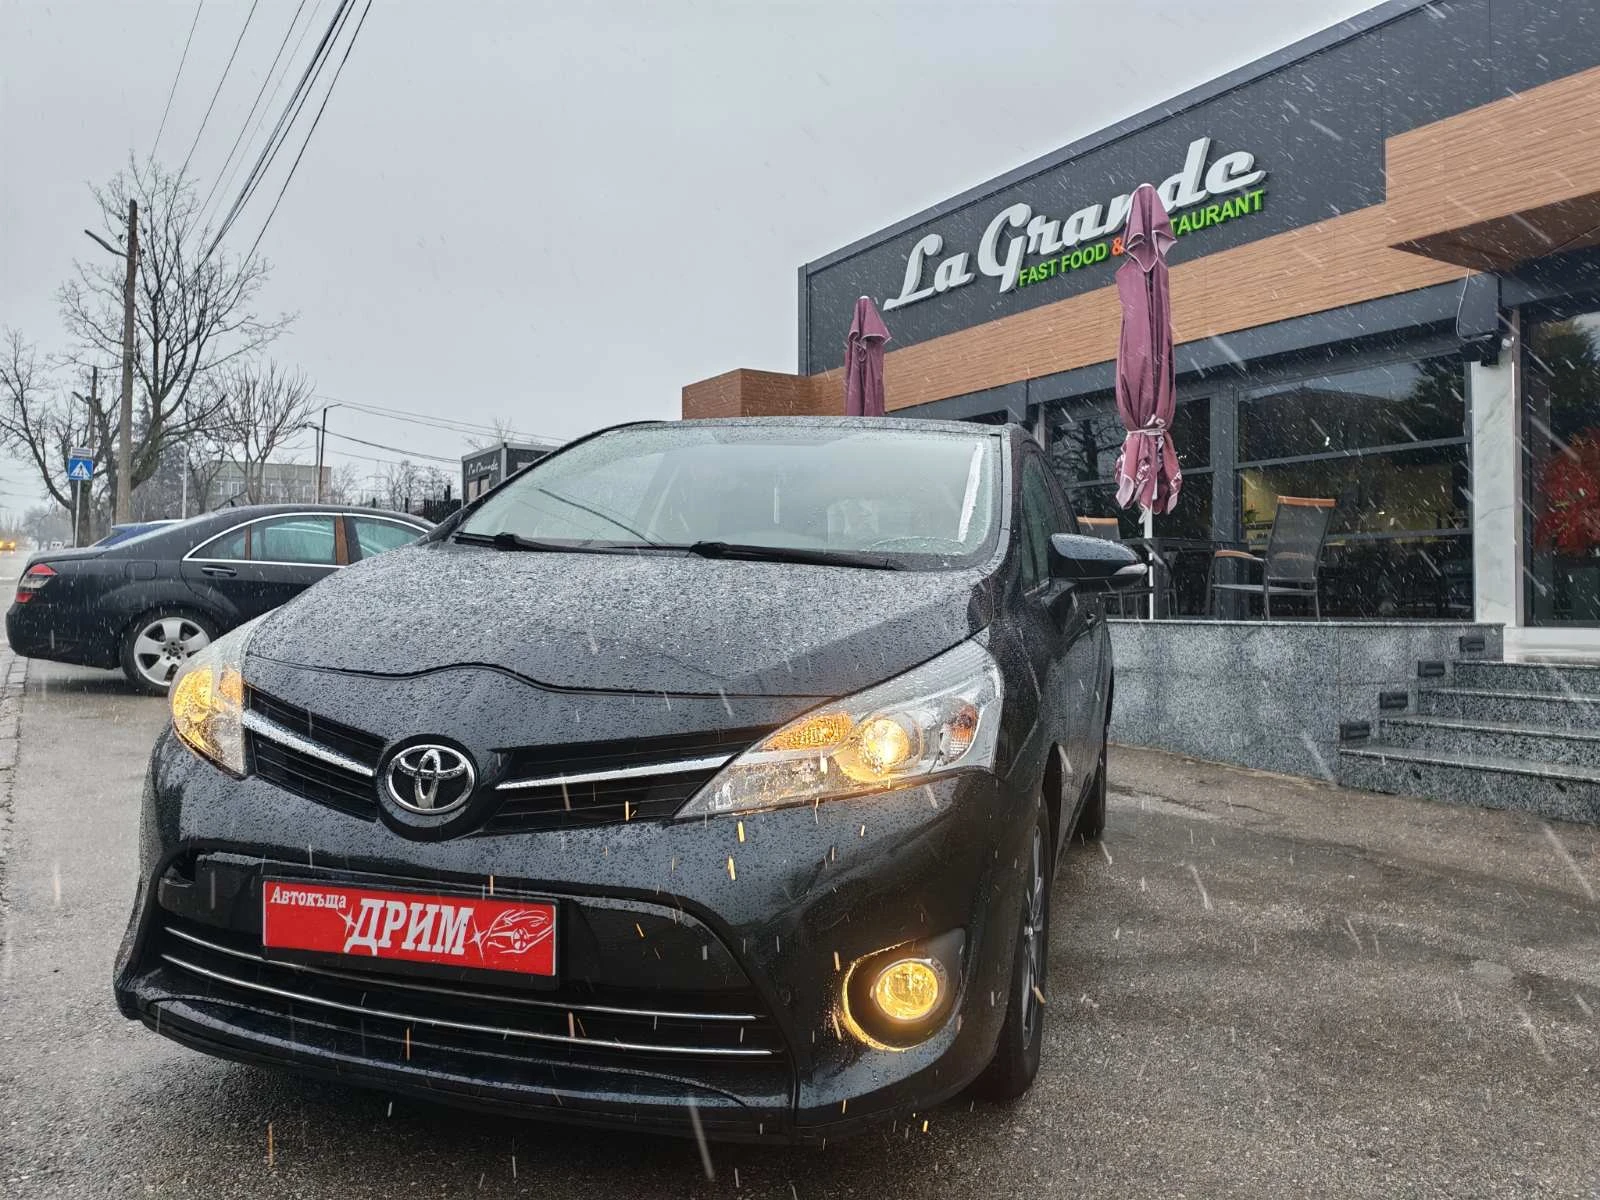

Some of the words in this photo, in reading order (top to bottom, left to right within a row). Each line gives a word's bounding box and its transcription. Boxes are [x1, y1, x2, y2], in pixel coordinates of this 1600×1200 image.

[883, 233, 975, 311] La
[1019, 258, 1058, 287] FAST
[1061, 242, 1107, 273] FOOD
[1112, 236, 1124, 256] &
[1169, 189, 1265, 236] TAURANT
[270, 885, 347, 911] Автокъща
[343, 897, 474, 957] ДРИМ
